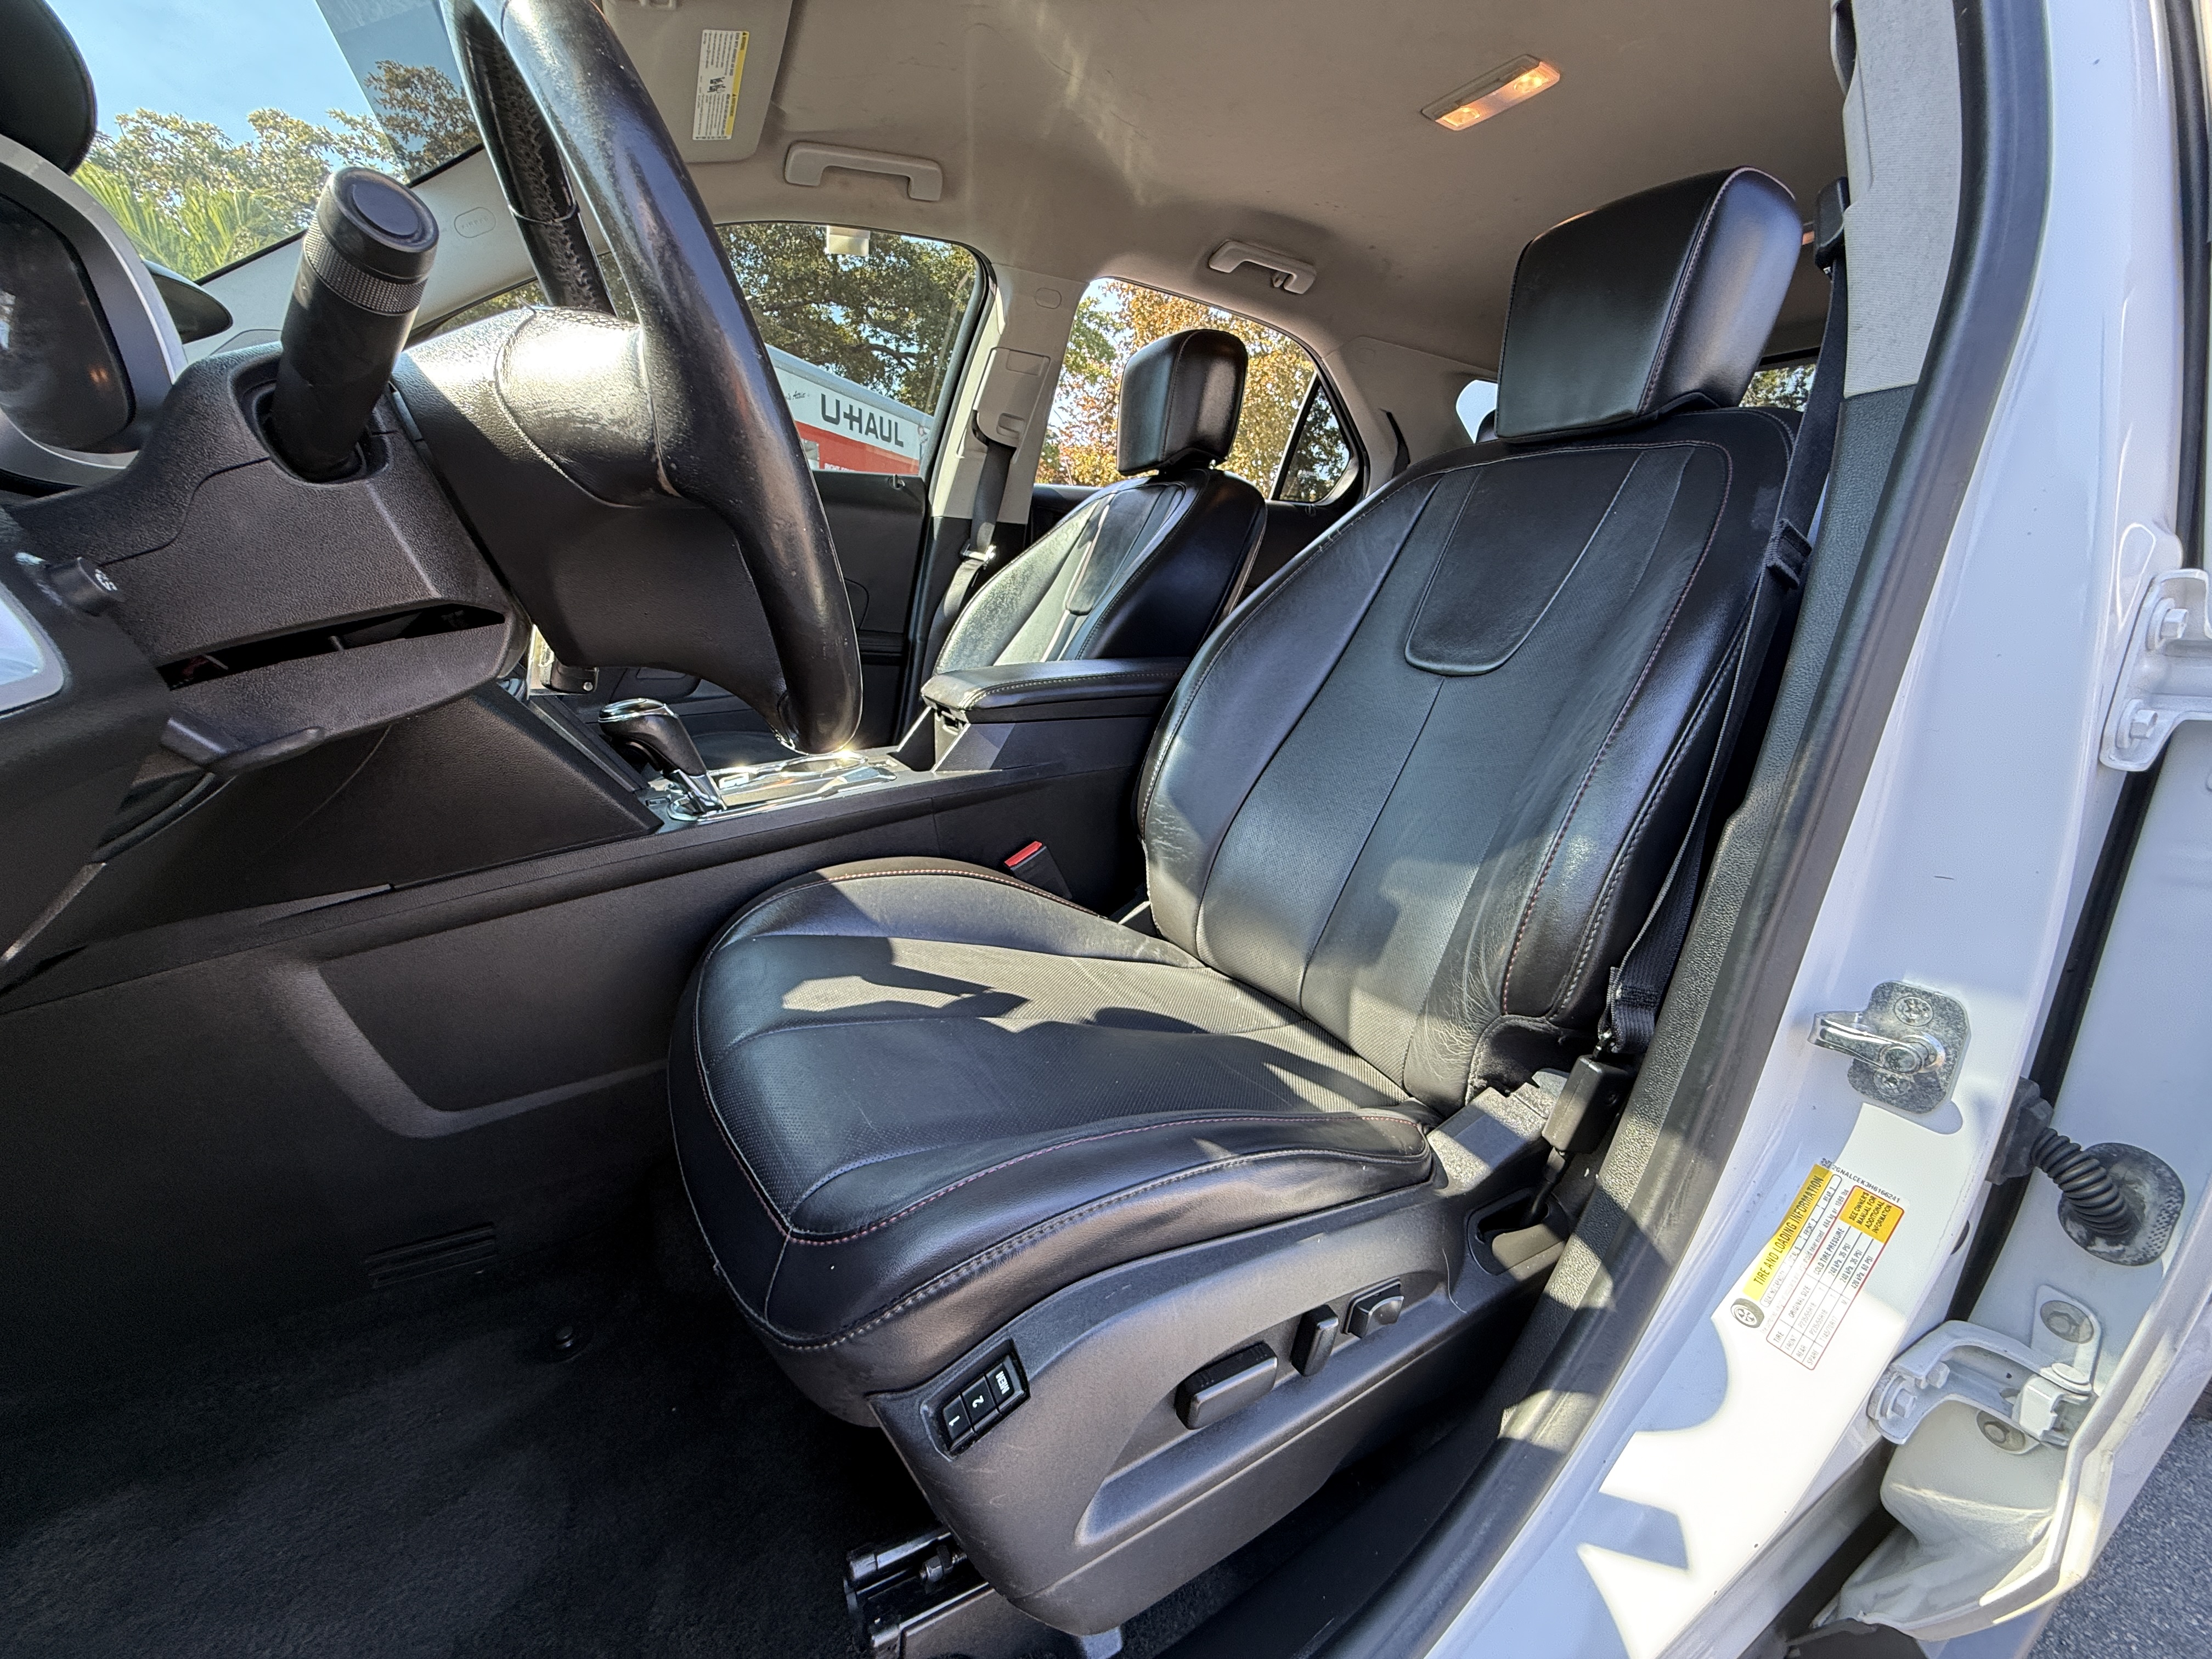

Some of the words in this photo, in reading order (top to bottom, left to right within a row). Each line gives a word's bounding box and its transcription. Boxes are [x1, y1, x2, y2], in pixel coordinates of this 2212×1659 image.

[821, 393, 904, 448] U-HAUL
[1848, 1210, 1858, 1221] SEE
[1853, 1191, 1869, 1212] OWNER'S
[1856, 1205, 1872, 1226] MANUAL
[1866, 1195, 1876, 1206] FOR
[1864, 1200, 1885, 1229] ADDITIONAL
[1753, 1267, 1770, 1285] TIRE
[1763, 1252, 1779, 1269] AND
[1773, 1221, 1797, 1254] LOADING
[1788, 1174, 1825, 1224] INFORMATION
[1871, 1205, 1892, 1234] INFORMATION
[1842, 1243, 1851, 1252] PSI
[1853, 1249, 1863, 1259] PSI
[1864, 1255, 1874, 1265] PSI
[1800, 1285, 1811, 1297] SIZE
[1814, 1262, 1825, 1275] COLD
[1820, 1251, 1831, 1263] TIRE
[1826, 1227, 1845, 1252] PRESSURE
[1849, 1257, 1858, 1265] 35
[996, 1371, 1010, 1395] MEM
[972, 1395, 984, 1408] 2
[949, 1415, 960, 1426] 1
